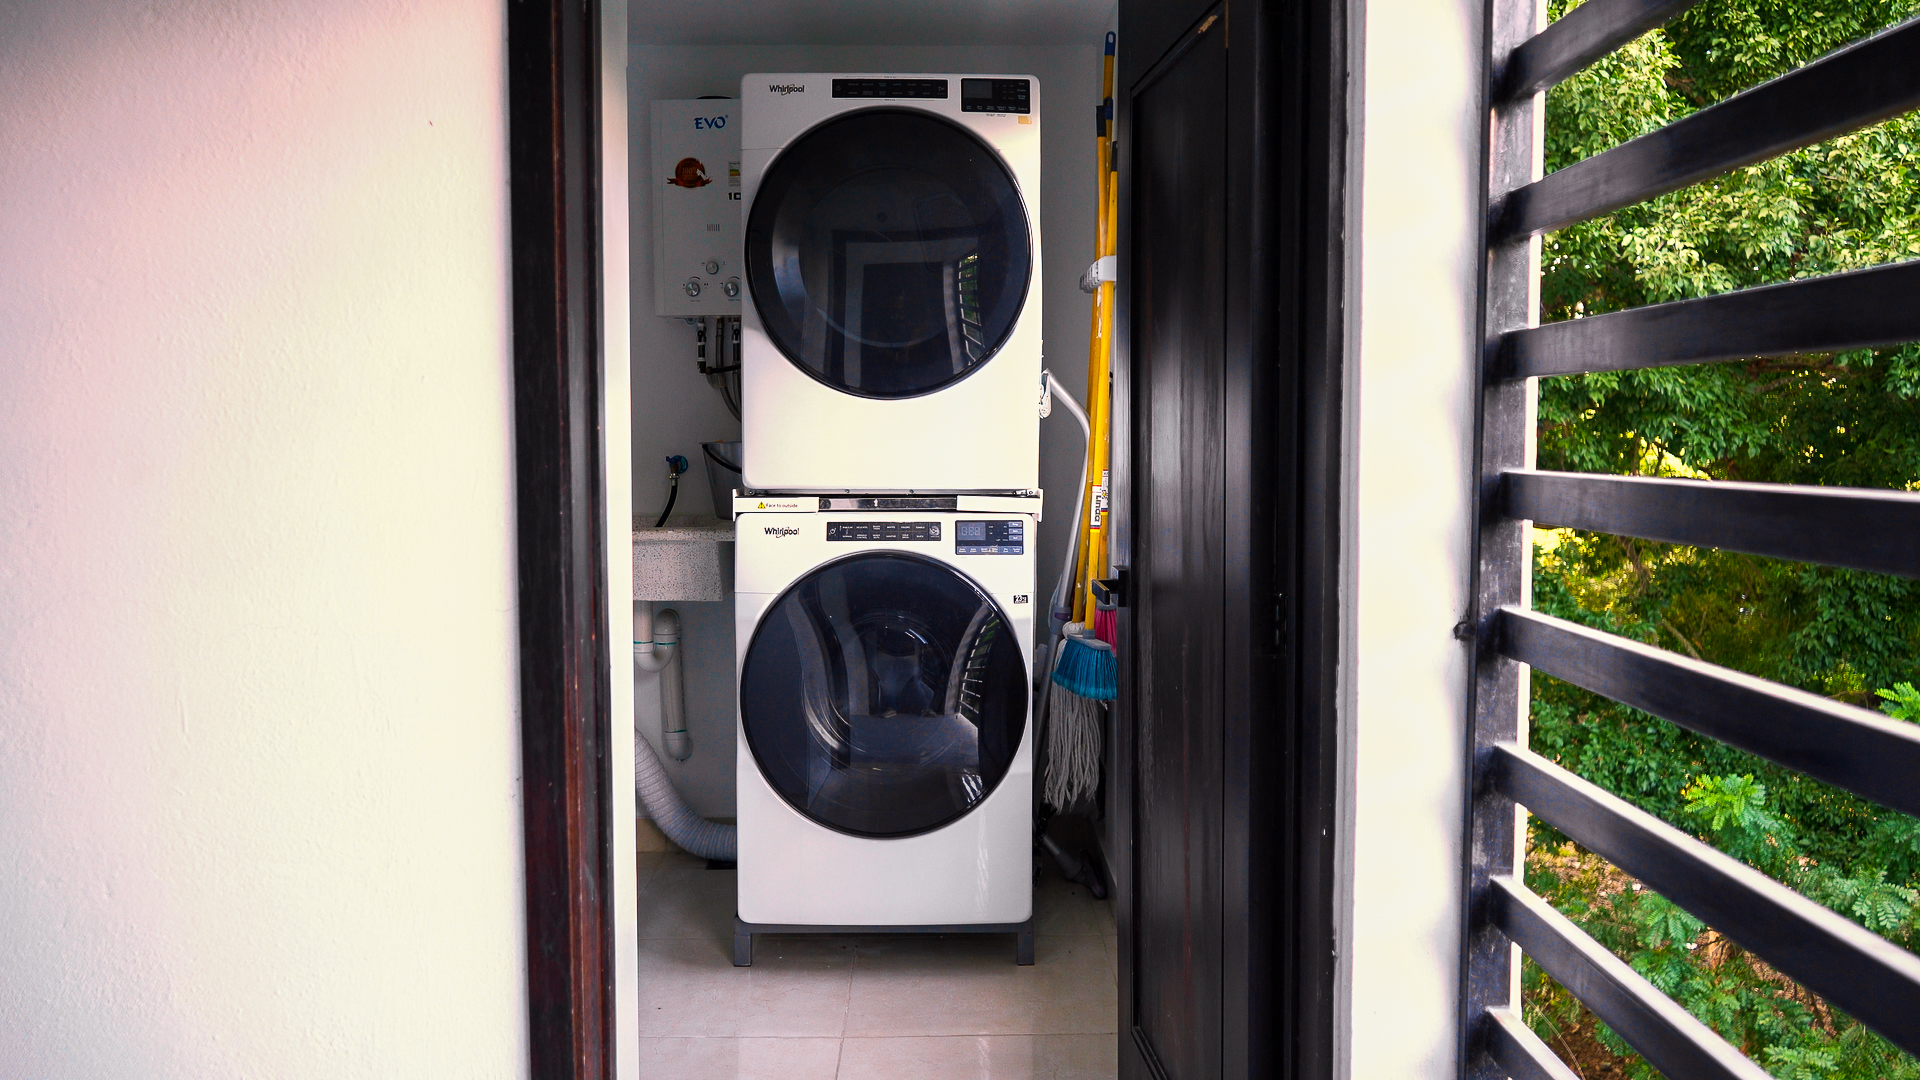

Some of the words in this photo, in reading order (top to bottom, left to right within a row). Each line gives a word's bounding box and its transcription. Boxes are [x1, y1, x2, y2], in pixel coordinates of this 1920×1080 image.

[769, 84, 805, 95] Whirlpool
[693, 116, 726, 129] EVO
[764, 526, 800, 538] Whirlpool
